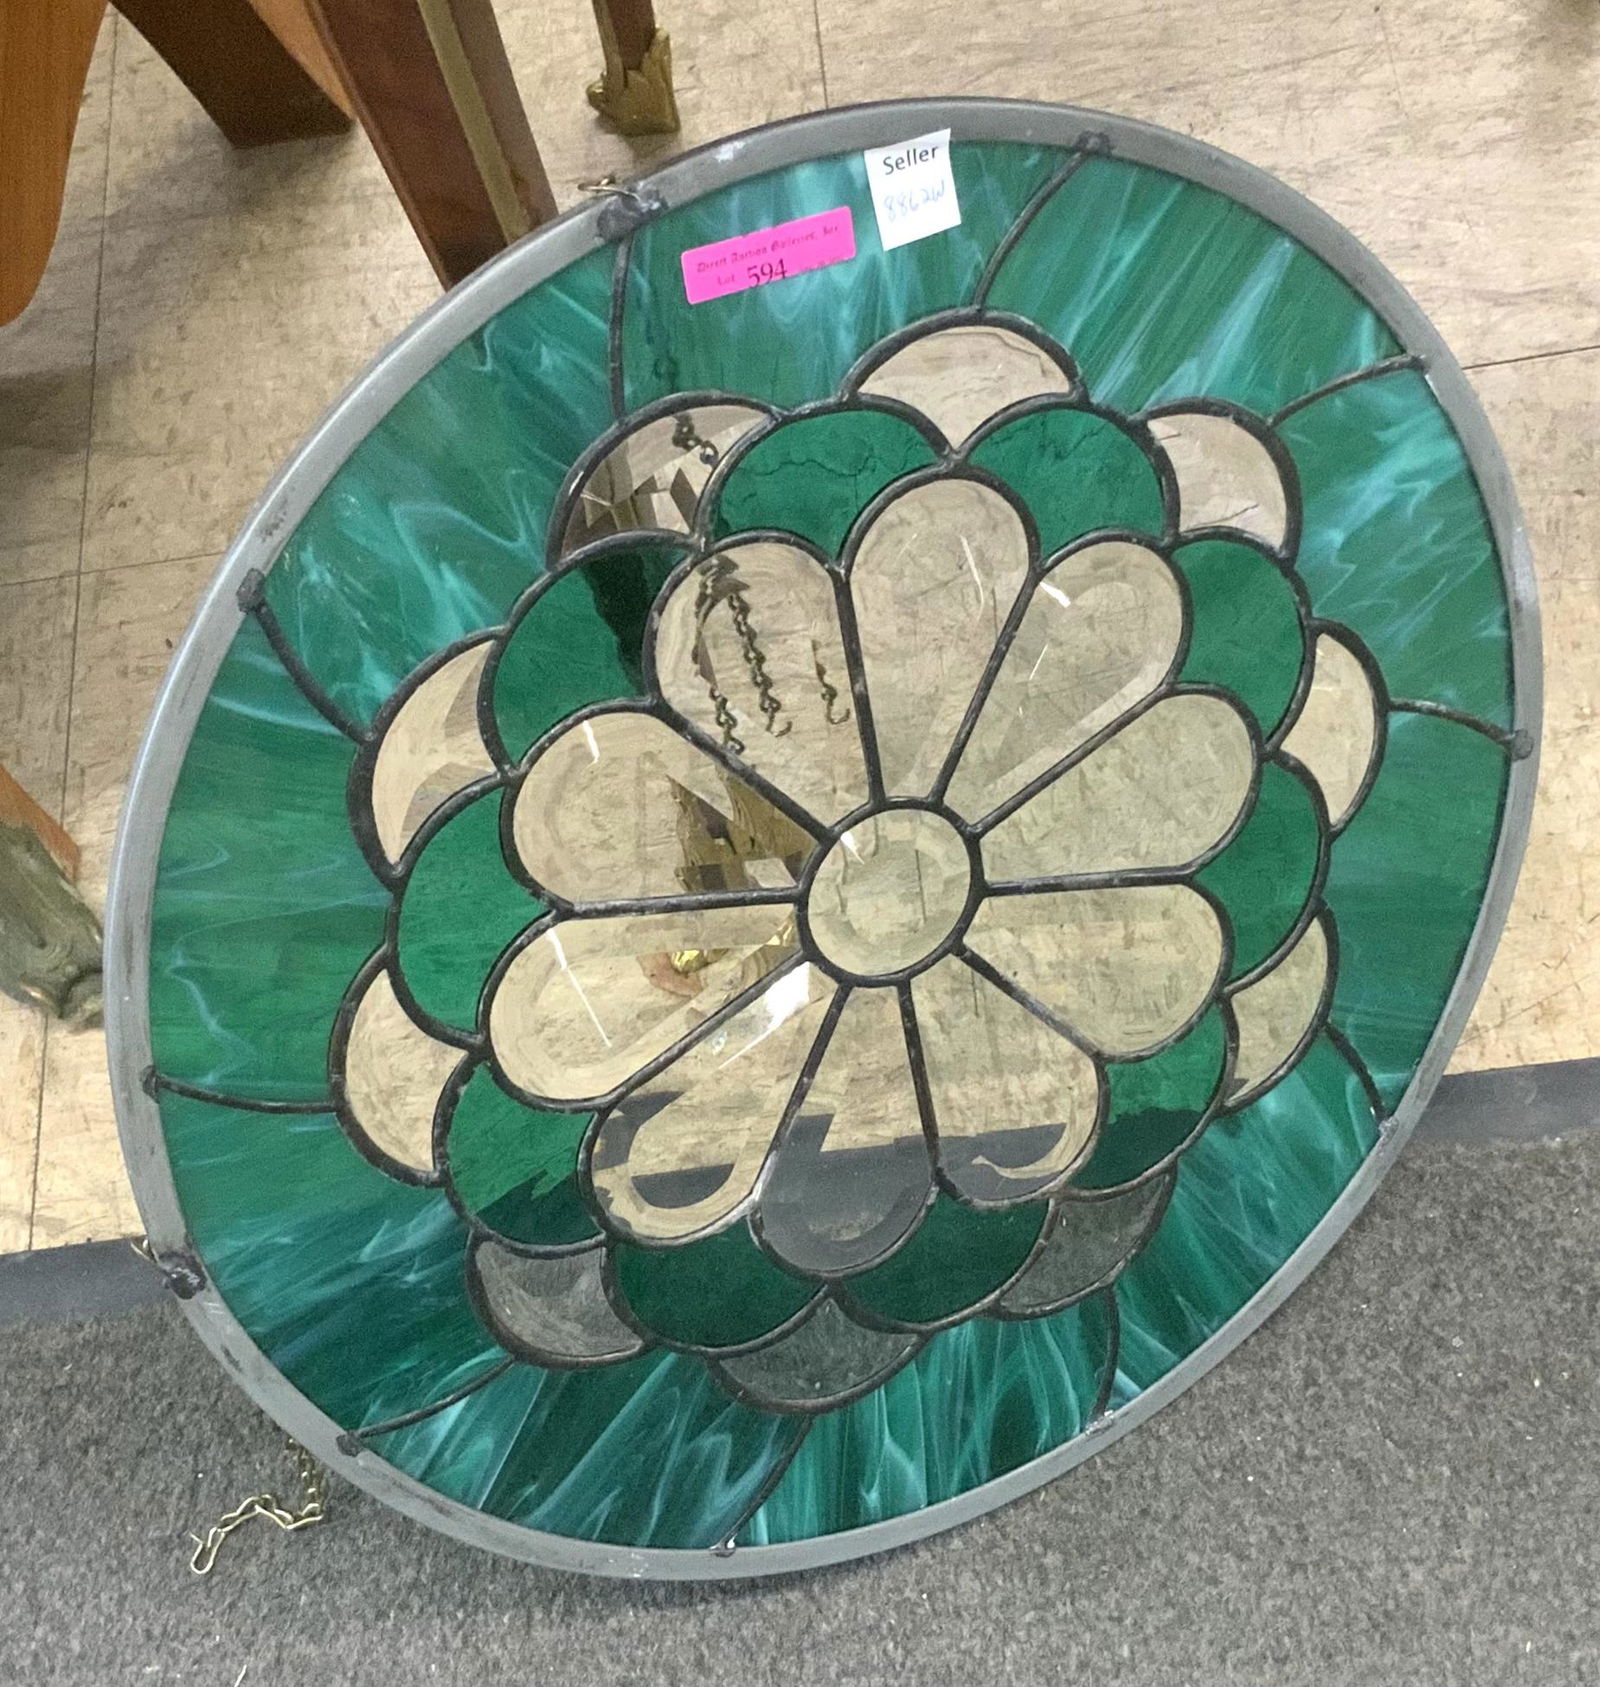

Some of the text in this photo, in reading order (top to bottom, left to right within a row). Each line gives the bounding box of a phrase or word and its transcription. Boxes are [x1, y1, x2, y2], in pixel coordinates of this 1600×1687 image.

[883, 146, 939, 175] Seller
[717, 273, 736, 286] Lot
[747, 258, 788, 289] 594
